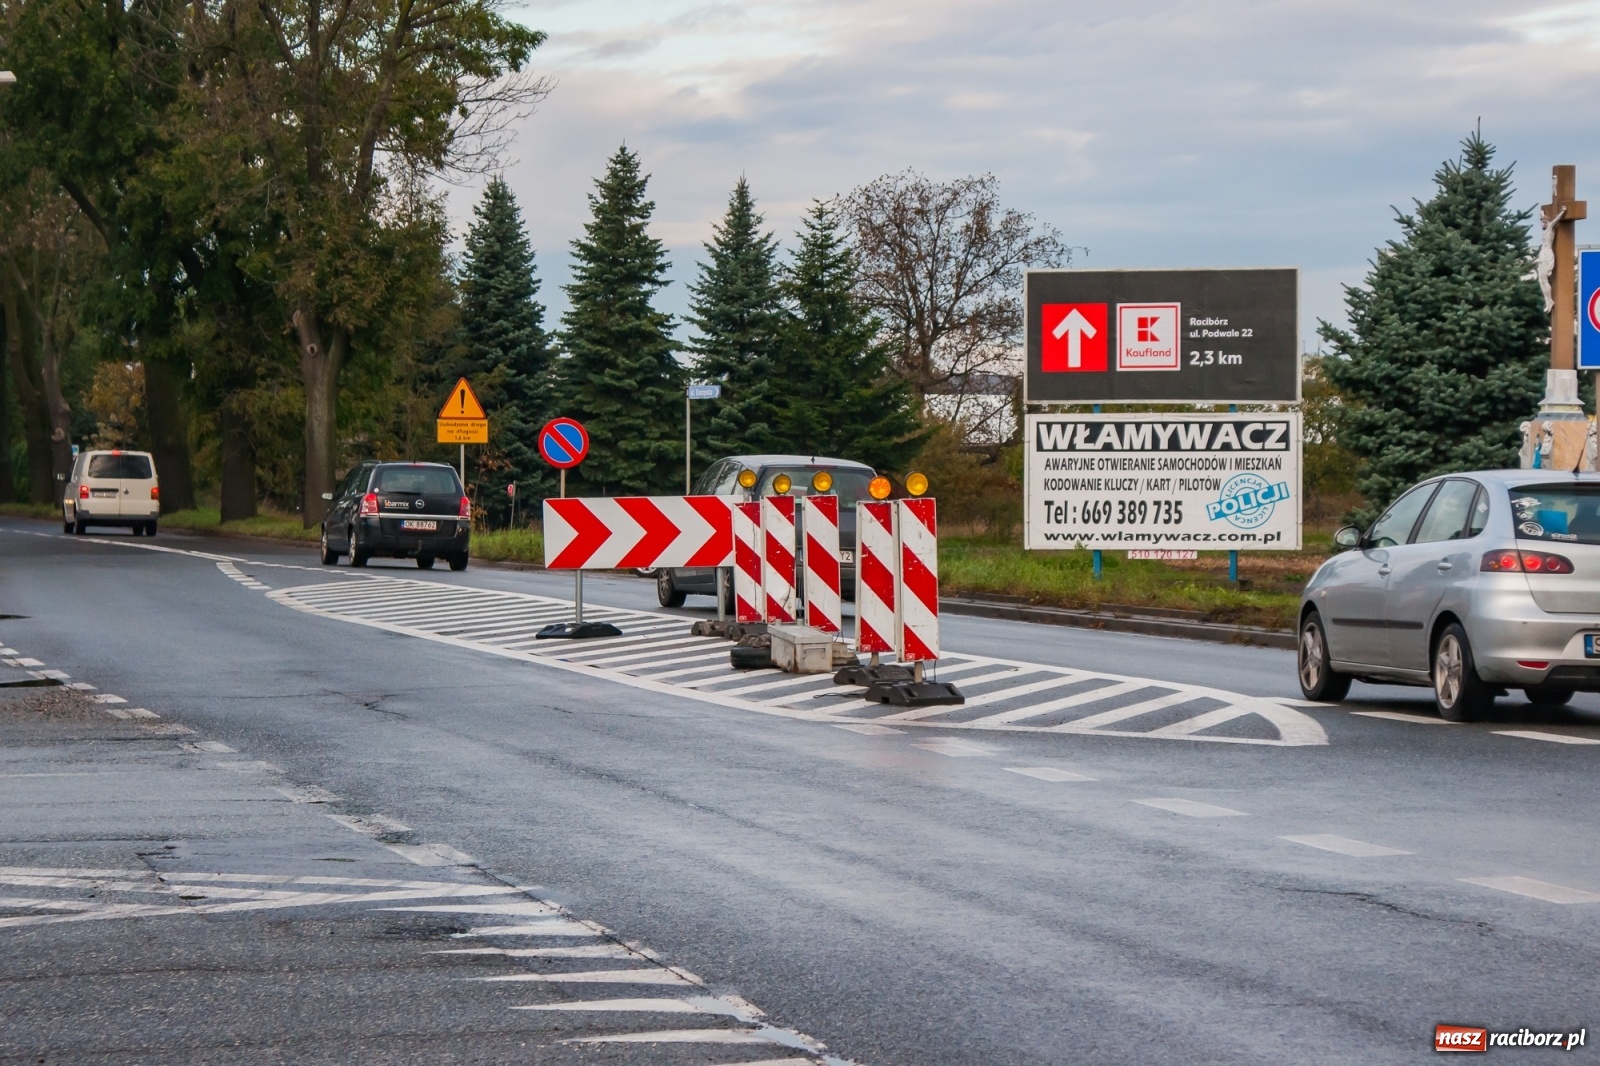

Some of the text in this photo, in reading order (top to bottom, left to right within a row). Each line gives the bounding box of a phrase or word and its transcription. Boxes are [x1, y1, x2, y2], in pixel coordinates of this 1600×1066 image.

[1189, 317, 1229, 326] Racibórz
[1189, 328, 1253, 338] ul. Podwale 22
[1126, 347, 1172, 358] Kaufland
[1189, 350, 1243, 367] 2,3 km
[1038, 422, 1288, 451] WŁAMYWACZ
[1044, 454, 1282, 471] AWARYJNE OTWIERANIE SAMOCHODÓW I MIESZKAŃ
[1043, 478, 1102, 491] KODOWANIE
[1104, 478, 1140, 491] KLUCZY
[1146, 478, 1171, 491] KART
[1178, 475, 1222, 491] PILOTÓW
[1225, 477, 1263, 498] LICENCJA
[1207, 484, 1289, 521] POLICJI
[1081, 500, 1112, 525] 669
[1116, 500, 1148, 525] 389
[1153, 500, 1183, 525] 735
[1044, 531, 1282, 545] www.wlamywacz.com.pl
[1131, 550, 1150, 559] 510
[1176, 550, 1195, 559] 127
